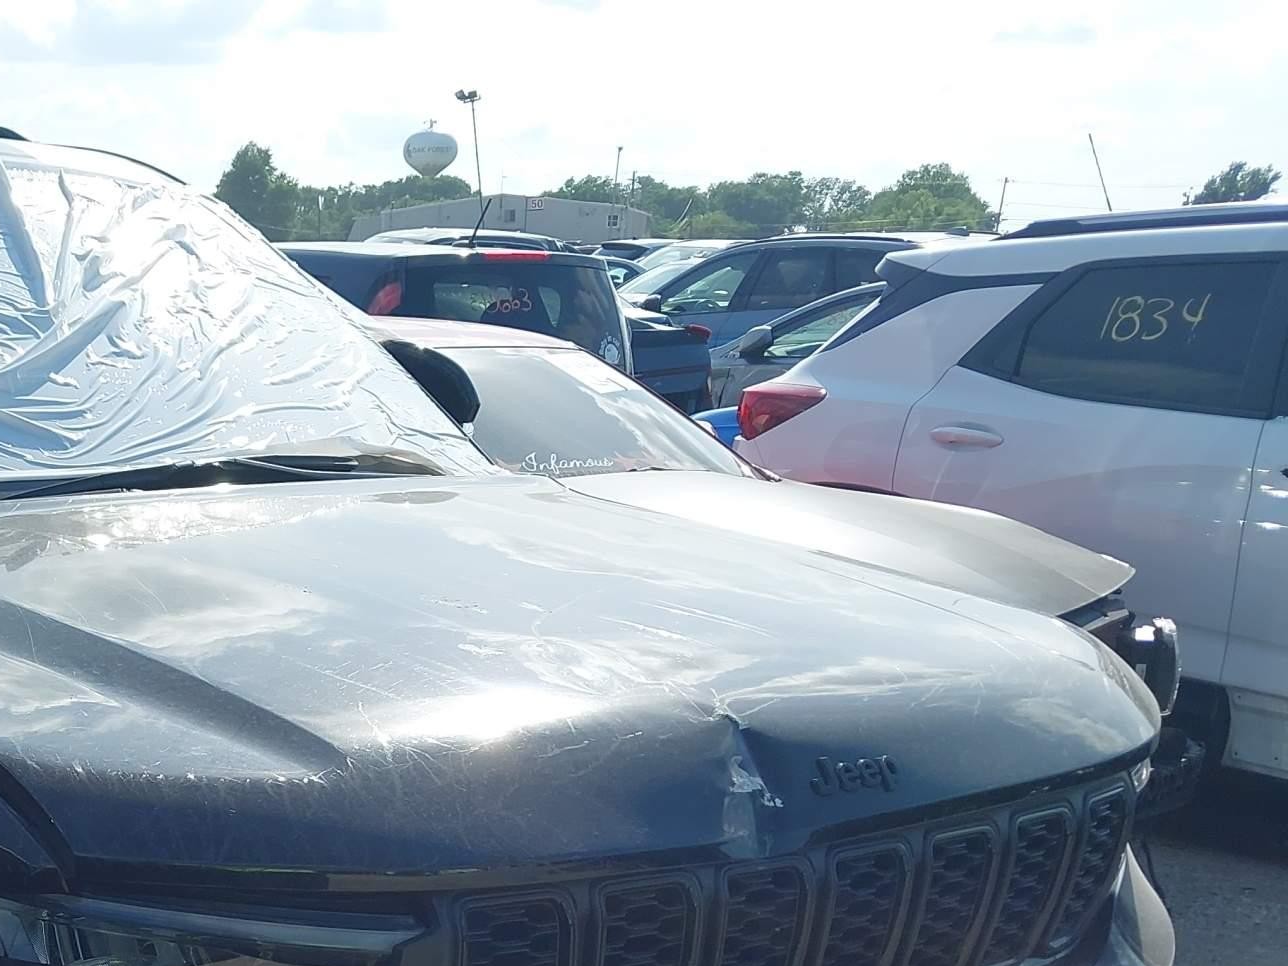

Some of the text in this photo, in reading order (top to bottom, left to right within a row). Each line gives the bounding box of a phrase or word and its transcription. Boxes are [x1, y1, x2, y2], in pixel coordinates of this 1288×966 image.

[531, 199, 543, 209] 50
[1099, 293, 1212, 342] 1834
[522, 451, 614, 474] Infamous
[809, 755, 897, 797] Jeep
